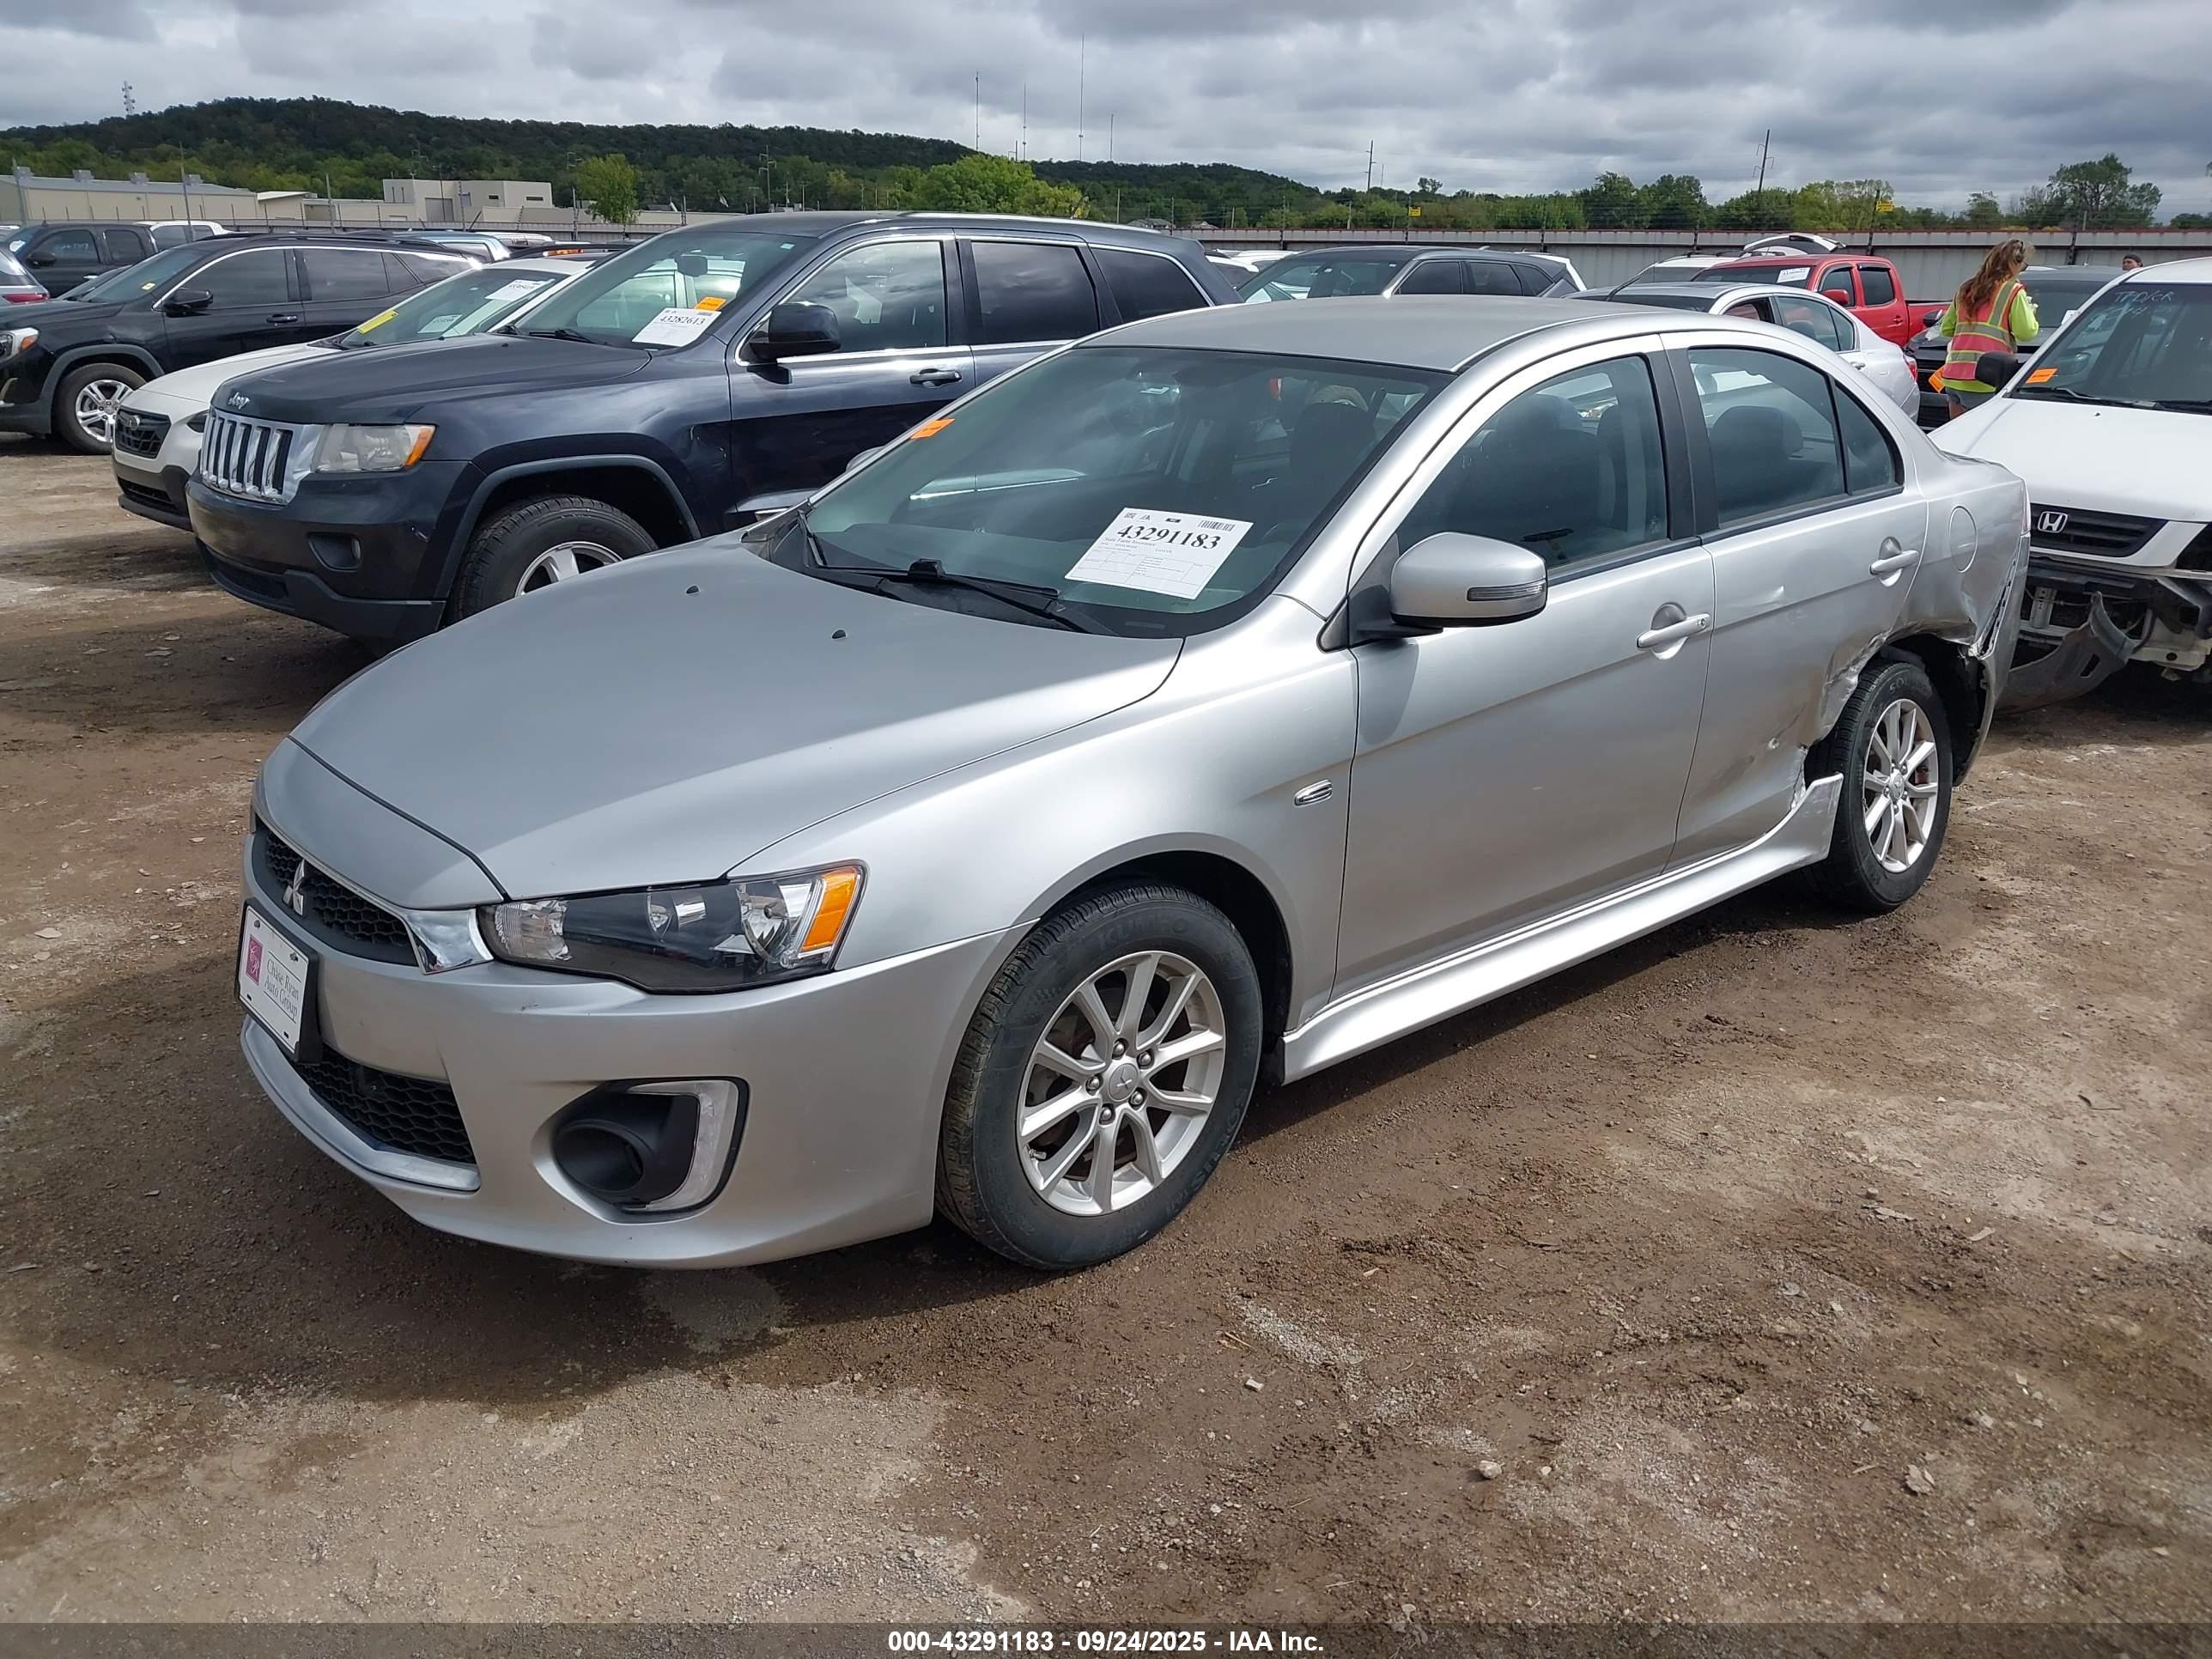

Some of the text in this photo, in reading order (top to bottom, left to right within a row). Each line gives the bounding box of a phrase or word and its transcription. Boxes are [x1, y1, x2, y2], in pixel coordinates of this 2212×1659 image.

[659, 314, 706, 325] 43282613
[1117, 524, 1221, 550] 43291183
[267, 958, 299, 1001] Chase Ryan
[264, 975, 298, 1019] Auto Group
